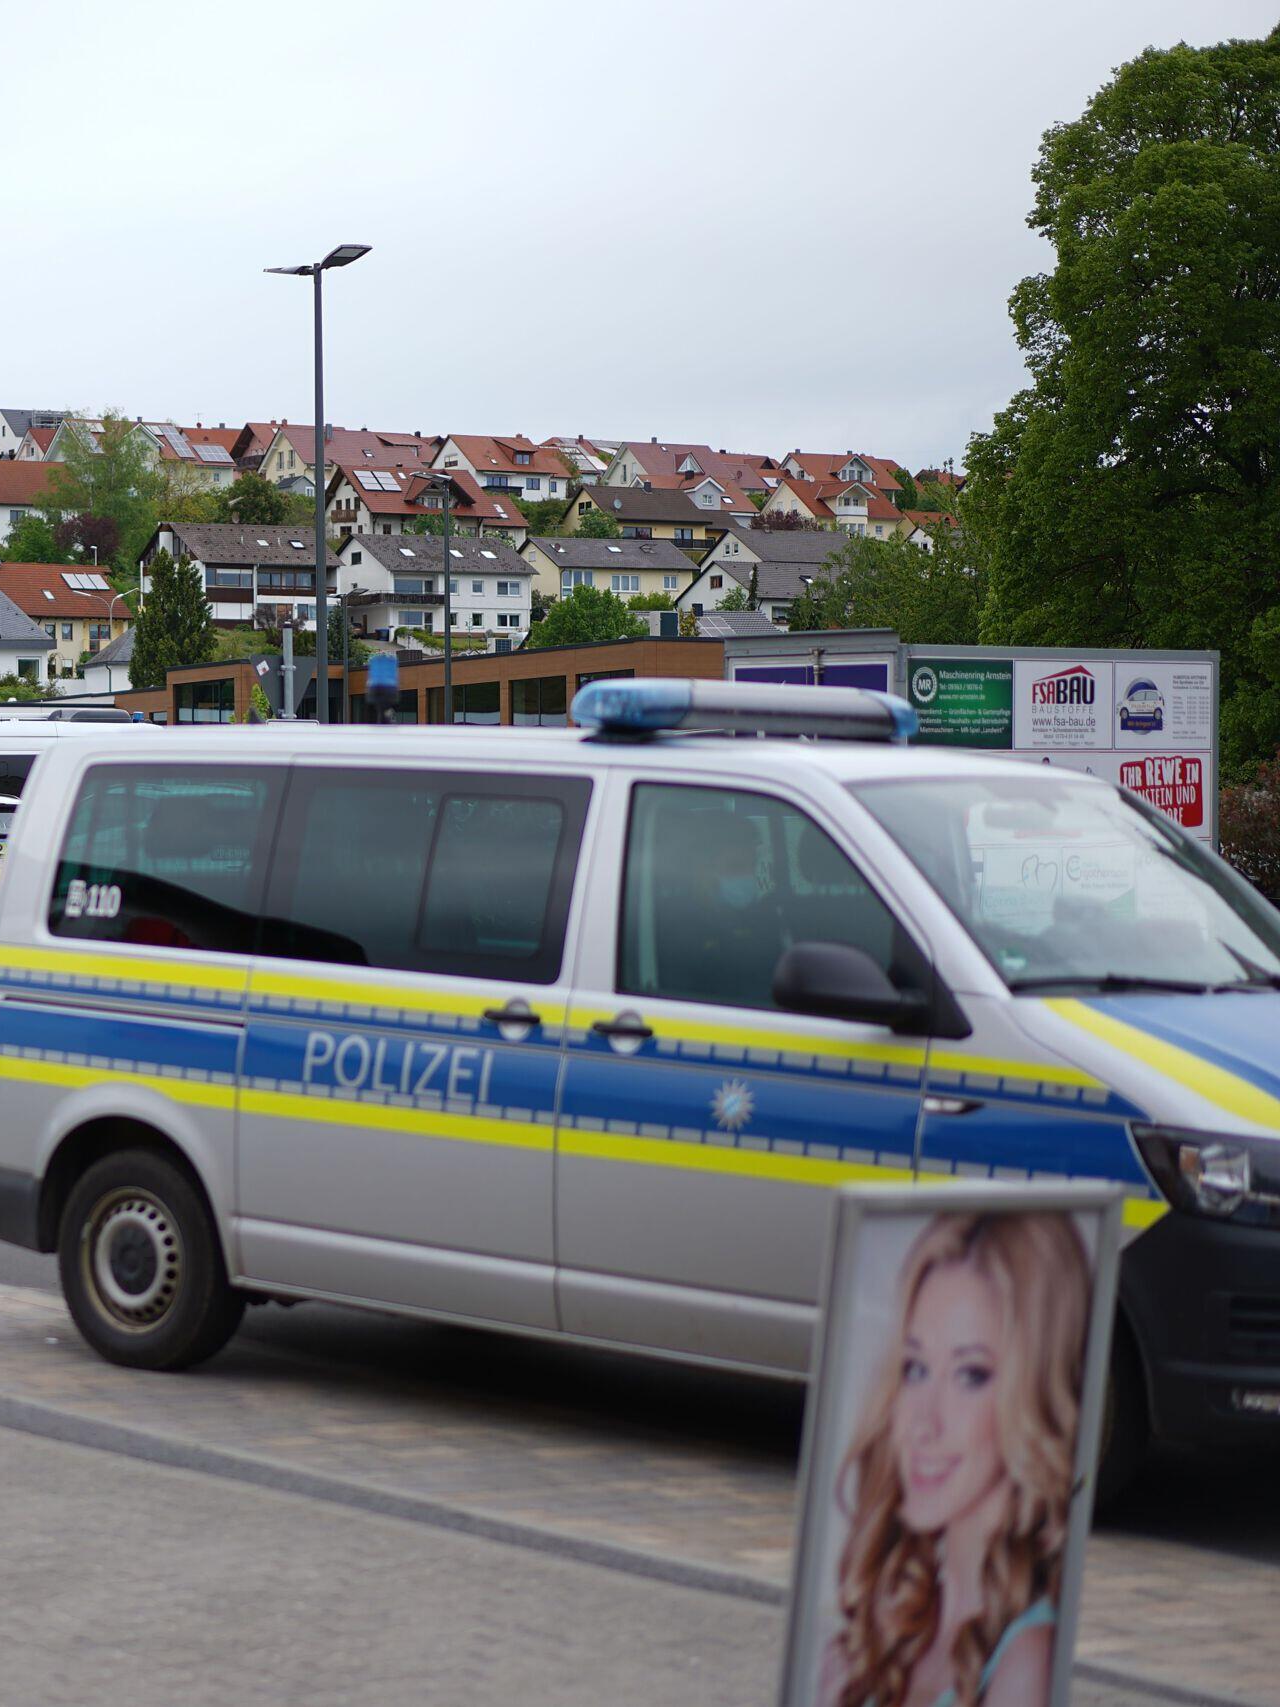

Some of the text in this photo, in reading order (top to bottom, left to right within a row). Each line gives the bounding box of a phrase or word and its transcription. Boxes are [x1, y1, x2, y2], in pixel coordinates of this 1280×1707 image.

[939, 670, 1011, 681] Maschinenring Arnstein
[918, 679, 932, 690] MR
[1032, 705, 1094, 714] BAUSTOFFE
[1032, 716, 1096, 727] www.fsa-bau.de
[1123, 758, 1199, 788] IHR REWE IN
[1134, 785, 1196, 807] NSTEIN UND
[85, 883, 122, 918] 110
[302, 1030, 495, 1105] POLIZEI
